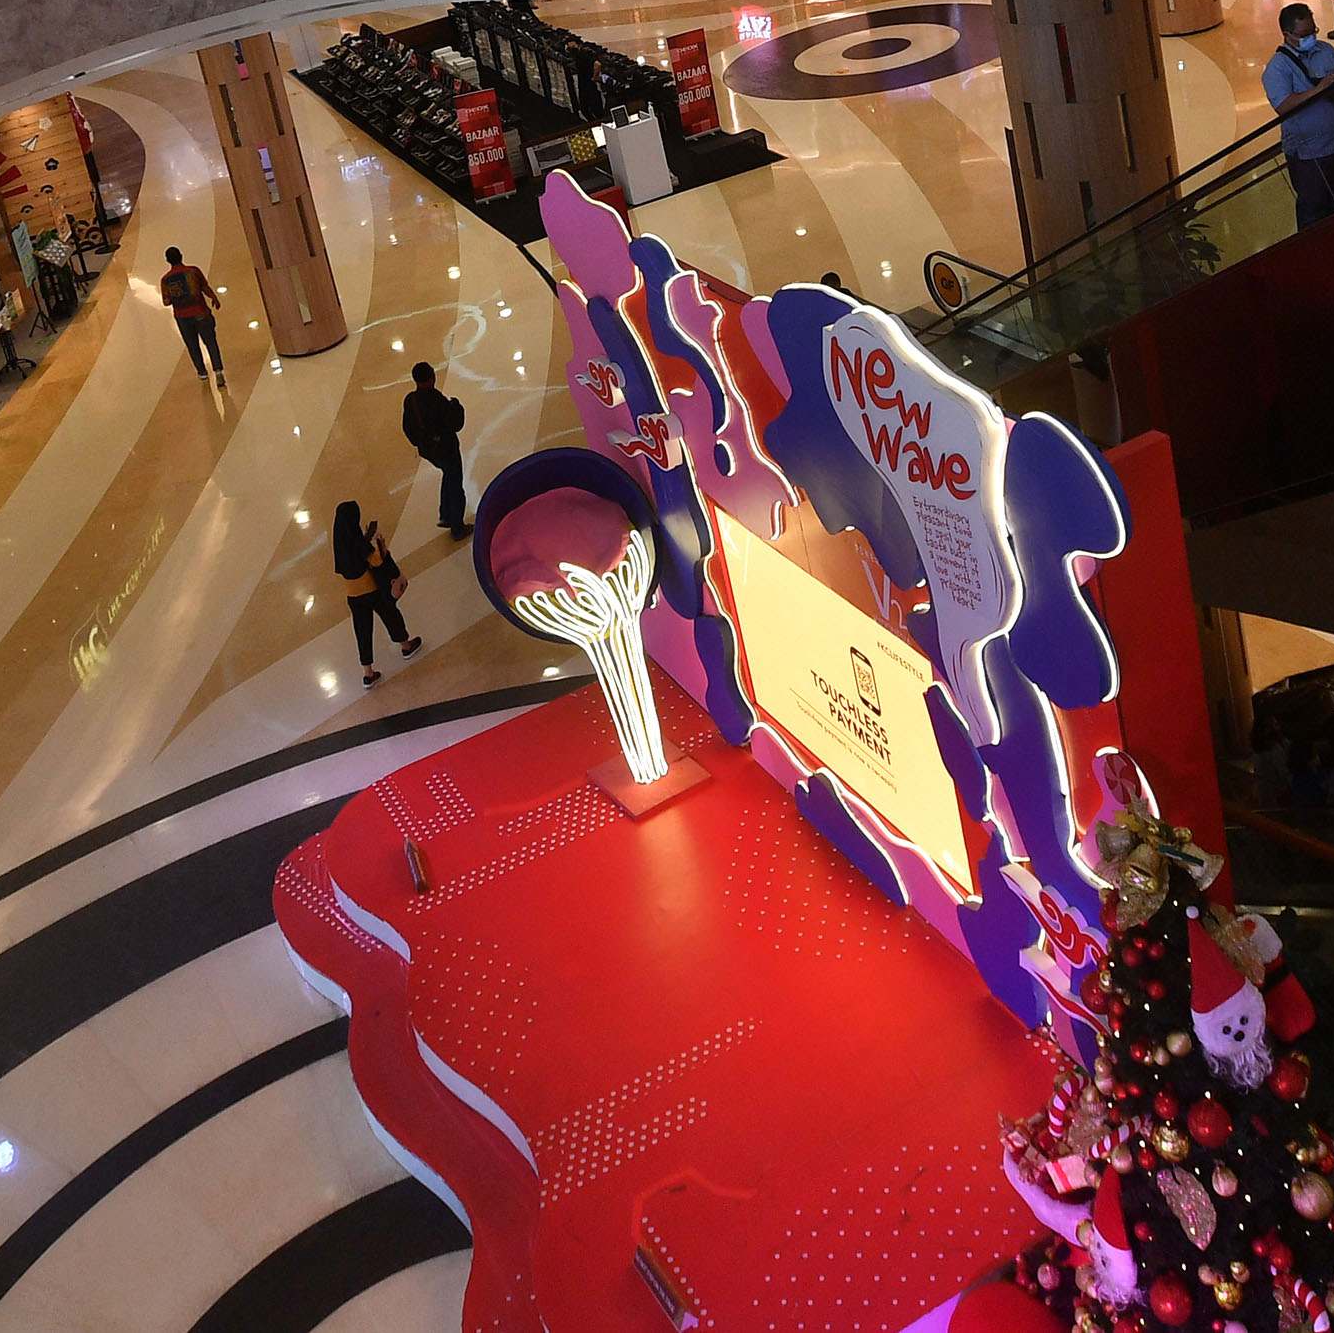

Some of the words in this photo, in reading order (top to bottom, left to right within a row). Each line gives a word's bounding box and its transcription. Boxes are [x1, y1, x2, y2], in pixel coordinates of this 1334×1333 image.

[676, 65, 708, 82] BAZAAR
[465, 126, 500, 143] BAZAAR
[831, 336, 932, 440] New
[861, 413, 977, 501] Wave
[913, 496, 970, 530] Extraordinary
[810, 669, 889, 746] TOUCHLESS
[828, 702, 892, 766] PAYMENT
